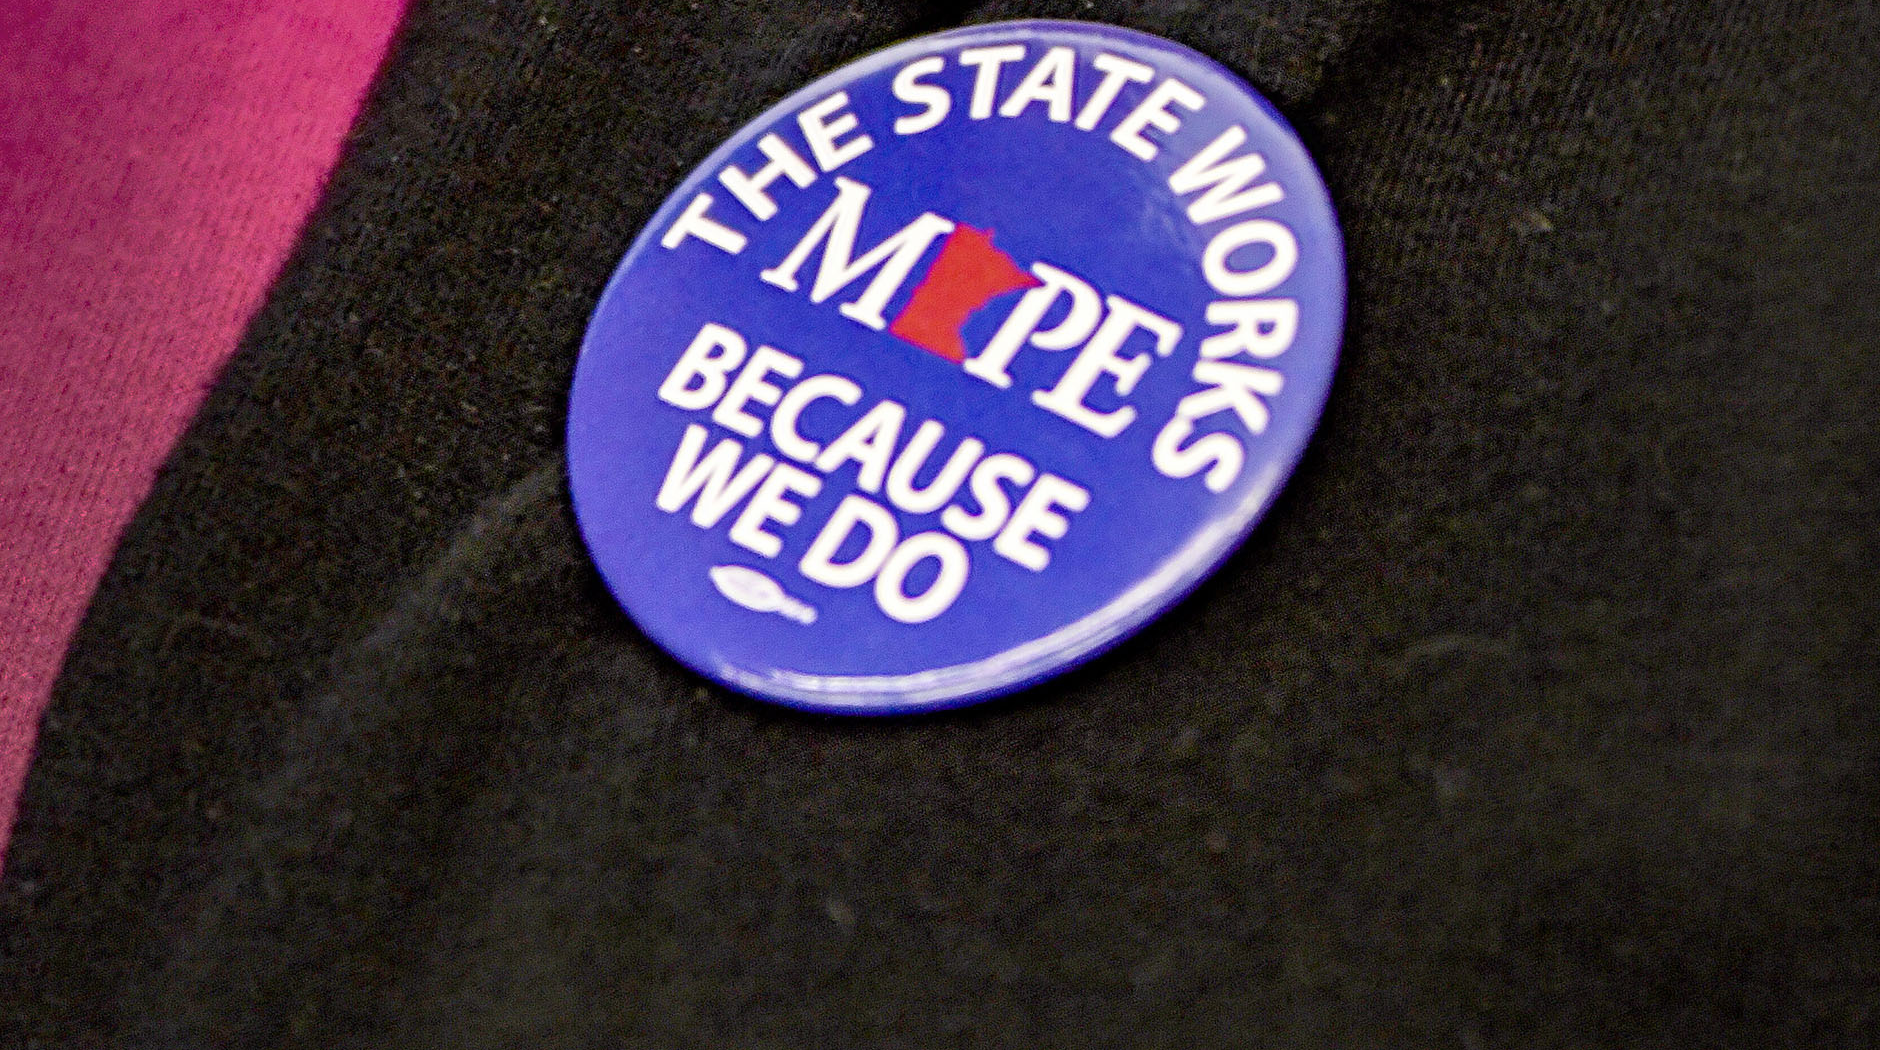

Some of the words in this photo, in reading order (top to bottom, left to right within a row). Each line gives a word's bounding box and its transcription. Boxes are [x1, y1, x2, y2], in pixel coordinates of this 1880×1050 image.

[662, 91, 873, 256] THE
[891, 44, 1206, 161] STATE
[1151, 125, 1300, 494] WORKS
[655, 425, 820, 557] WE
[798, 495, 970, 624] DO
[657, 323, 1091, 572] BECAUSE
